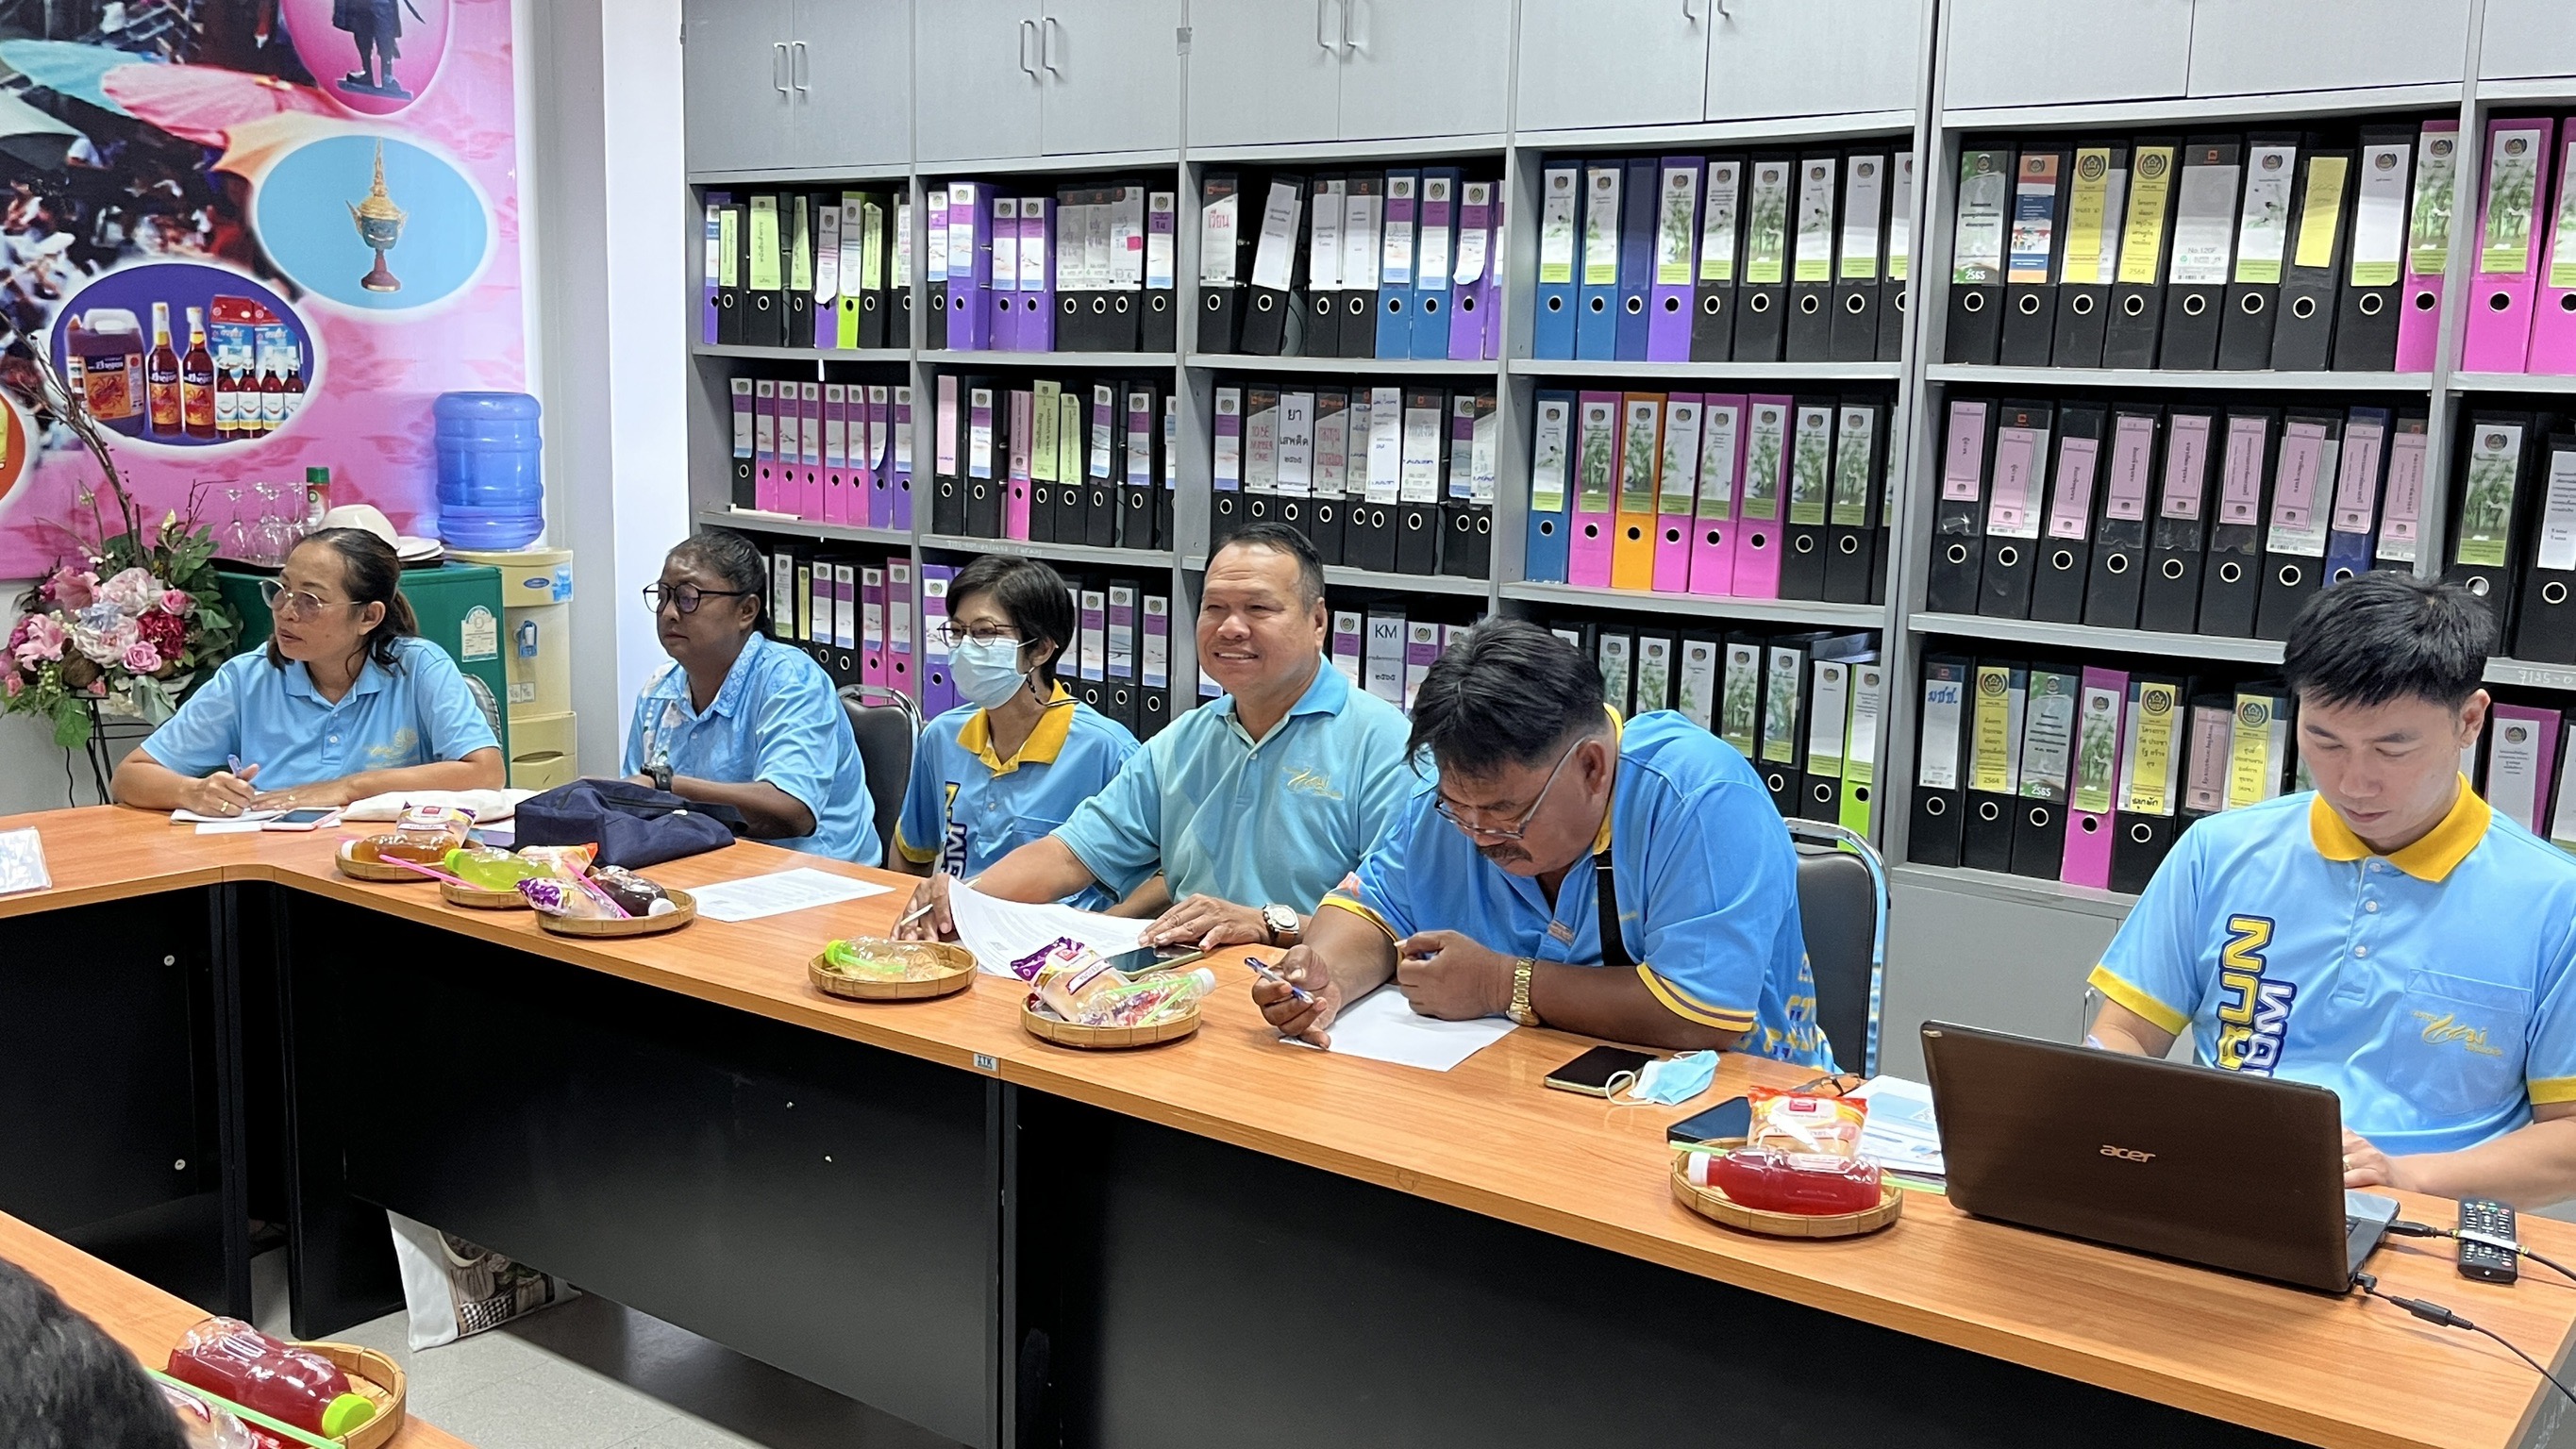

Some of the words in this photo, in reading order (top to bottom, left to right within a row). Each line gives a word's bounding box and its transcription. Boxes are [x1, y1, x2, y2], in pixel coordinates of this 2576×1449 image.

[1287, 408, 1302, 421] ยา
[1280, 434, 1309, 446] เสพติด
[1375, 624, 1397, 639] KM
[2218, 914, 2276, 1071] RUN
[2099, 1144, 2156, 1163] acer
